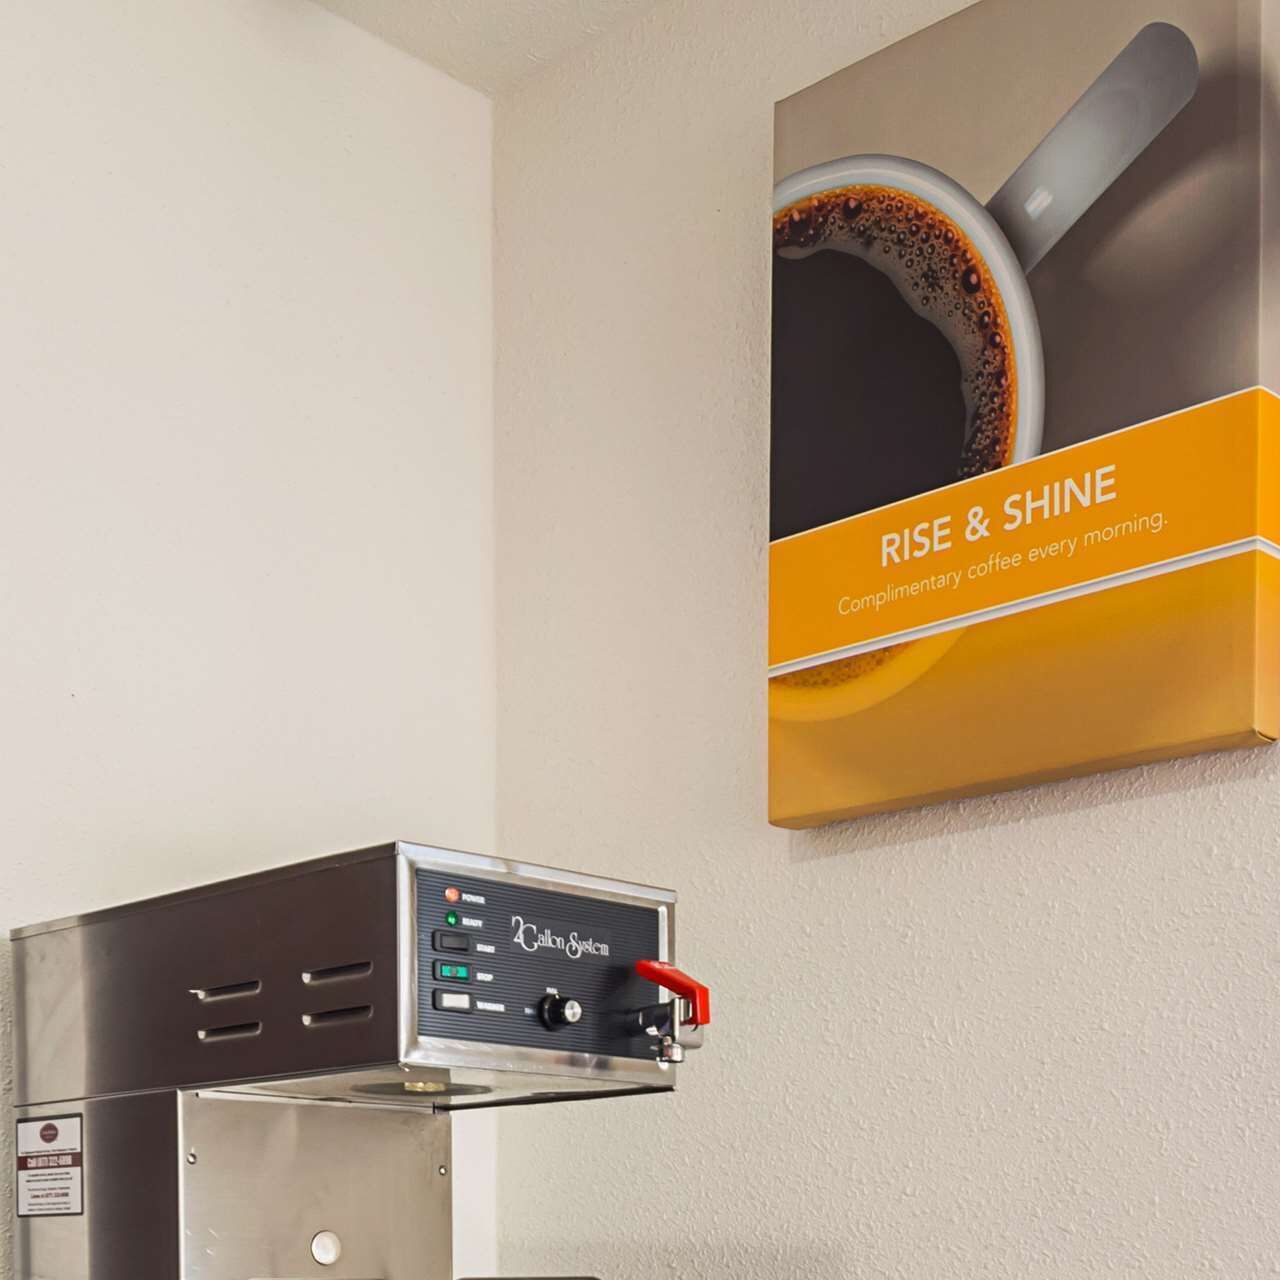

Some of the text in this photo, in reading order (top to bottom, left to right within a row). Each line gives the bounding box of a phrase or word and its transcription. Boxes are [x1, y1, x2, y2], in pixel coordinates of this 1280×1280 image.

[838, 511, 1168, 615] Complimentary coffee every morning.
[881, 464, 1117, 568] RISE & SHINE
[566, 932, 609, 958] System
